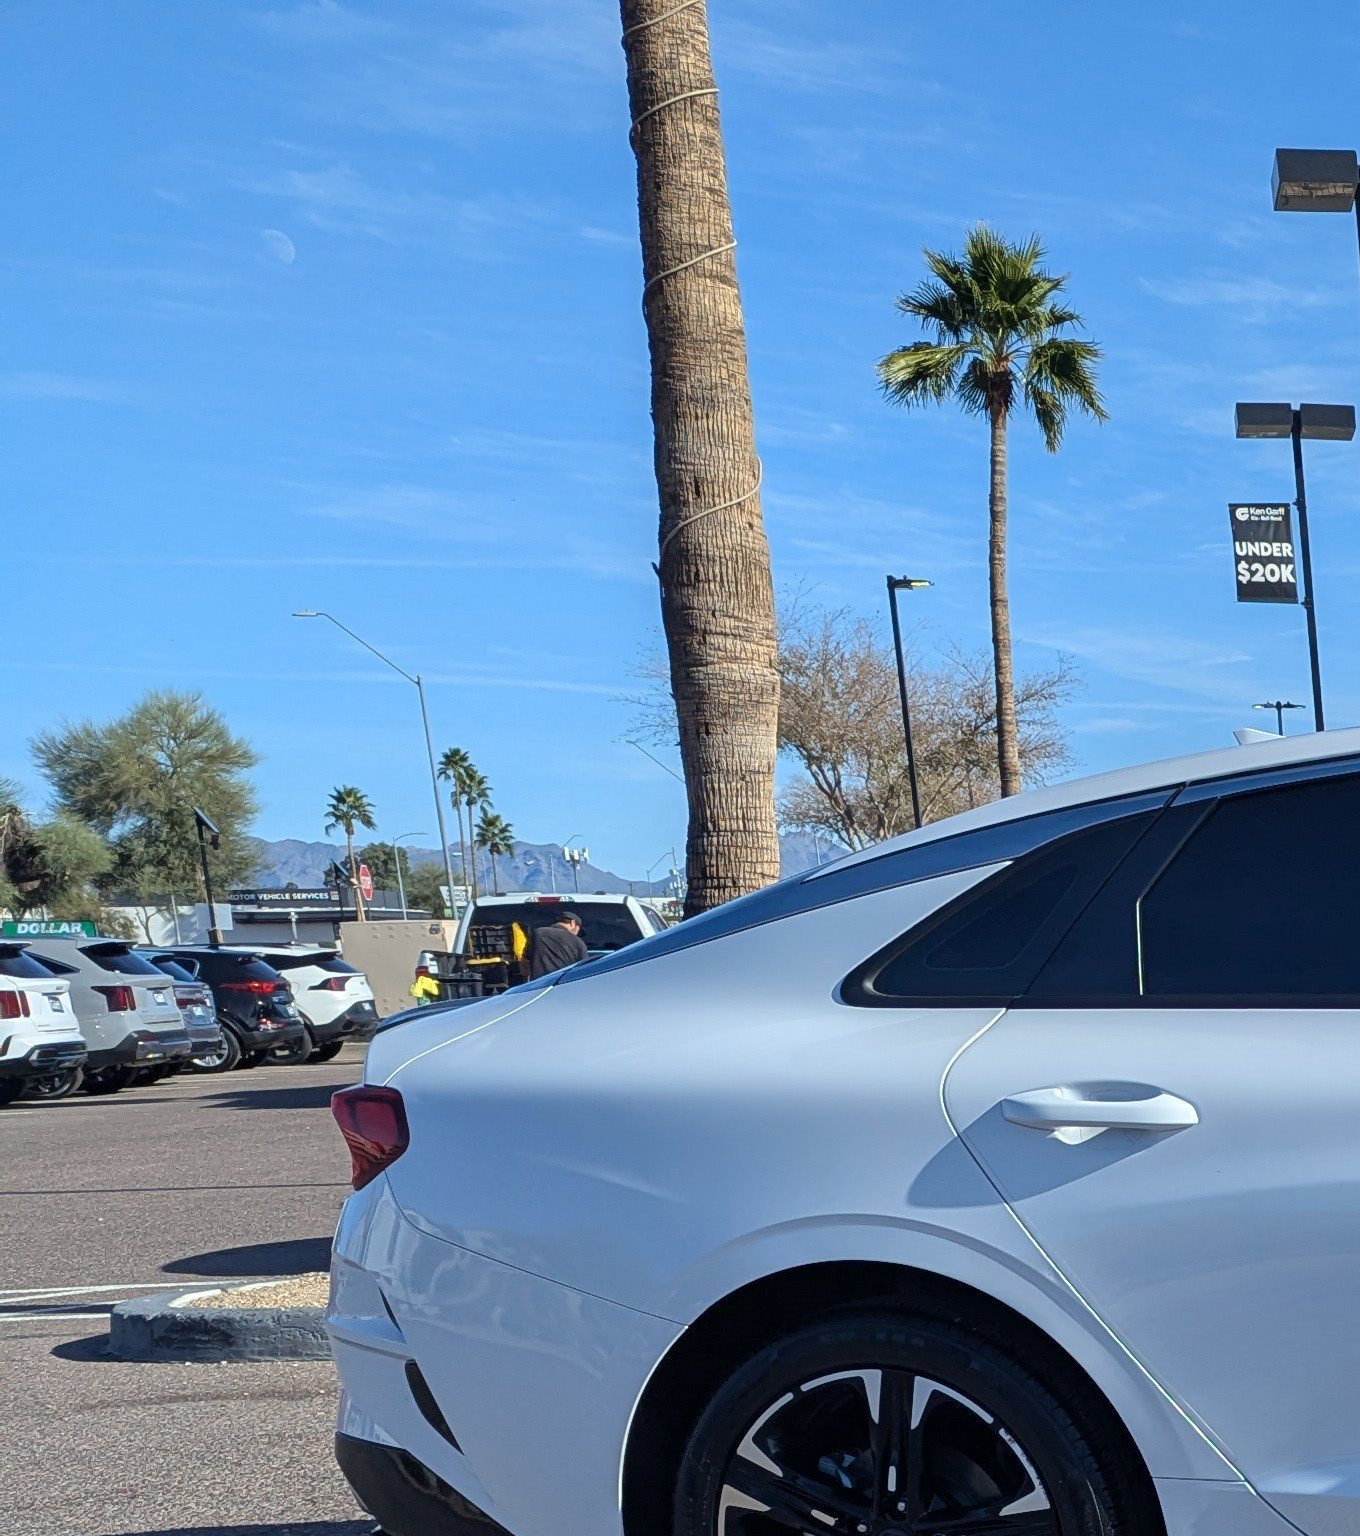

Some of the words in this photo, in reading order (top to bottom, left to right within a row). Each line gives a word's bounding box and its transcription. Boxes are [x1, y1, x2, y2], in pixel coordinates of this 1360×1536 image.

[1235, 541, 1294, 557] UNDER
[1237, 560, 1296, 584] $20K
[257, 892, 291, 901] VEHICLE
[291, 892, 329, 900] SERVICES
[16, 922, 82, 934] DOLLAR
